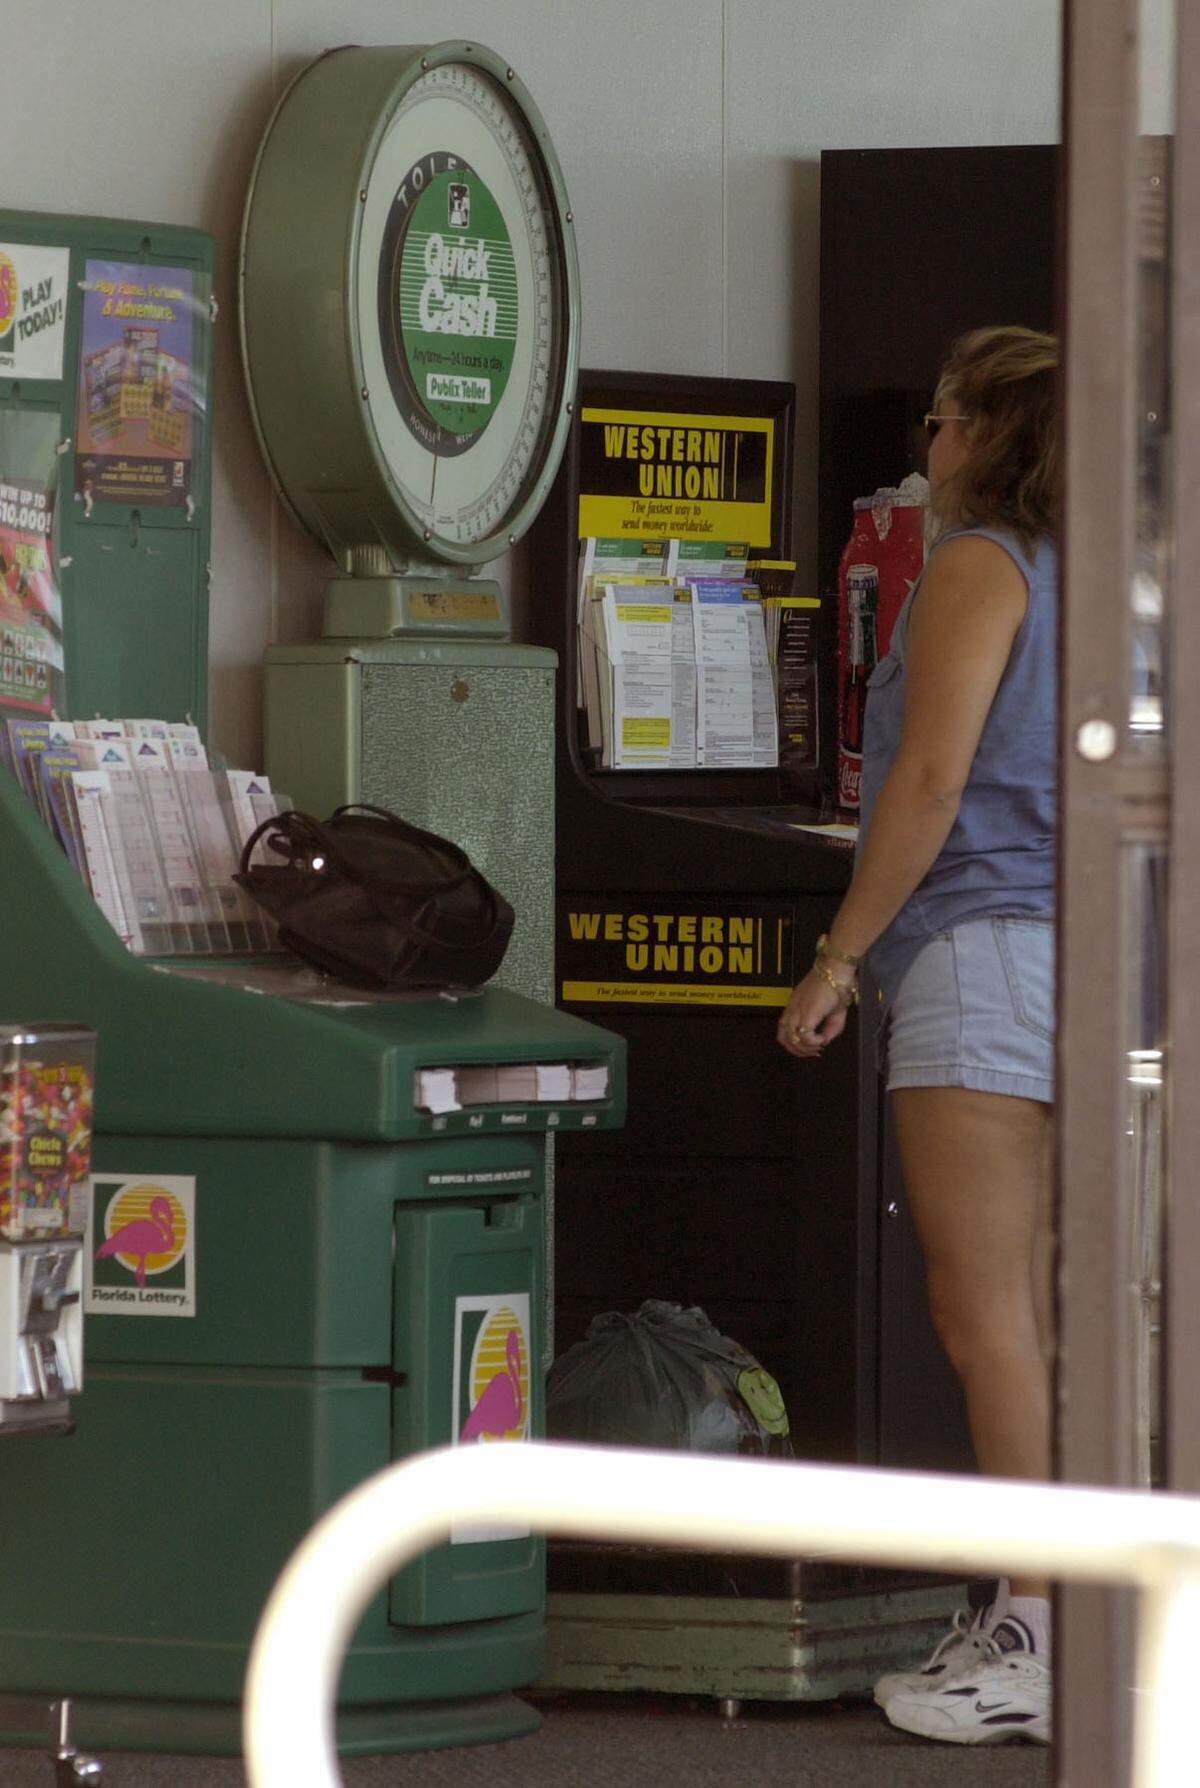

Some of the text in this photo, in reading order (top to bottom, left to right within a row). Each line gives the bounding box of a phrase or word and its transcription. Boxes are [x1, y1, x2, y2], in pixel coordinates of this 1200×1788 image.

[22, 277, 53, 311] PLAY
[419, 278, 497, 336] Cash
[17, 299, 62, 340] TODAY!
[431, 377, 486, 400] Publix Teller
[604, 425, 720, 463] WESTERN
[639, 463, 719, 499] UNION
[34, 493, 46, 509] TO
[632, 500, 701, 517] The fastest way to
[622, 518, 640, 529] send
[642, 520, 668, 533] money
[569, 913, 753, 944] WESTERN
[626, 944, 753, 973] UNION
[92, 1289, 185, 1306] Florida Lottery
